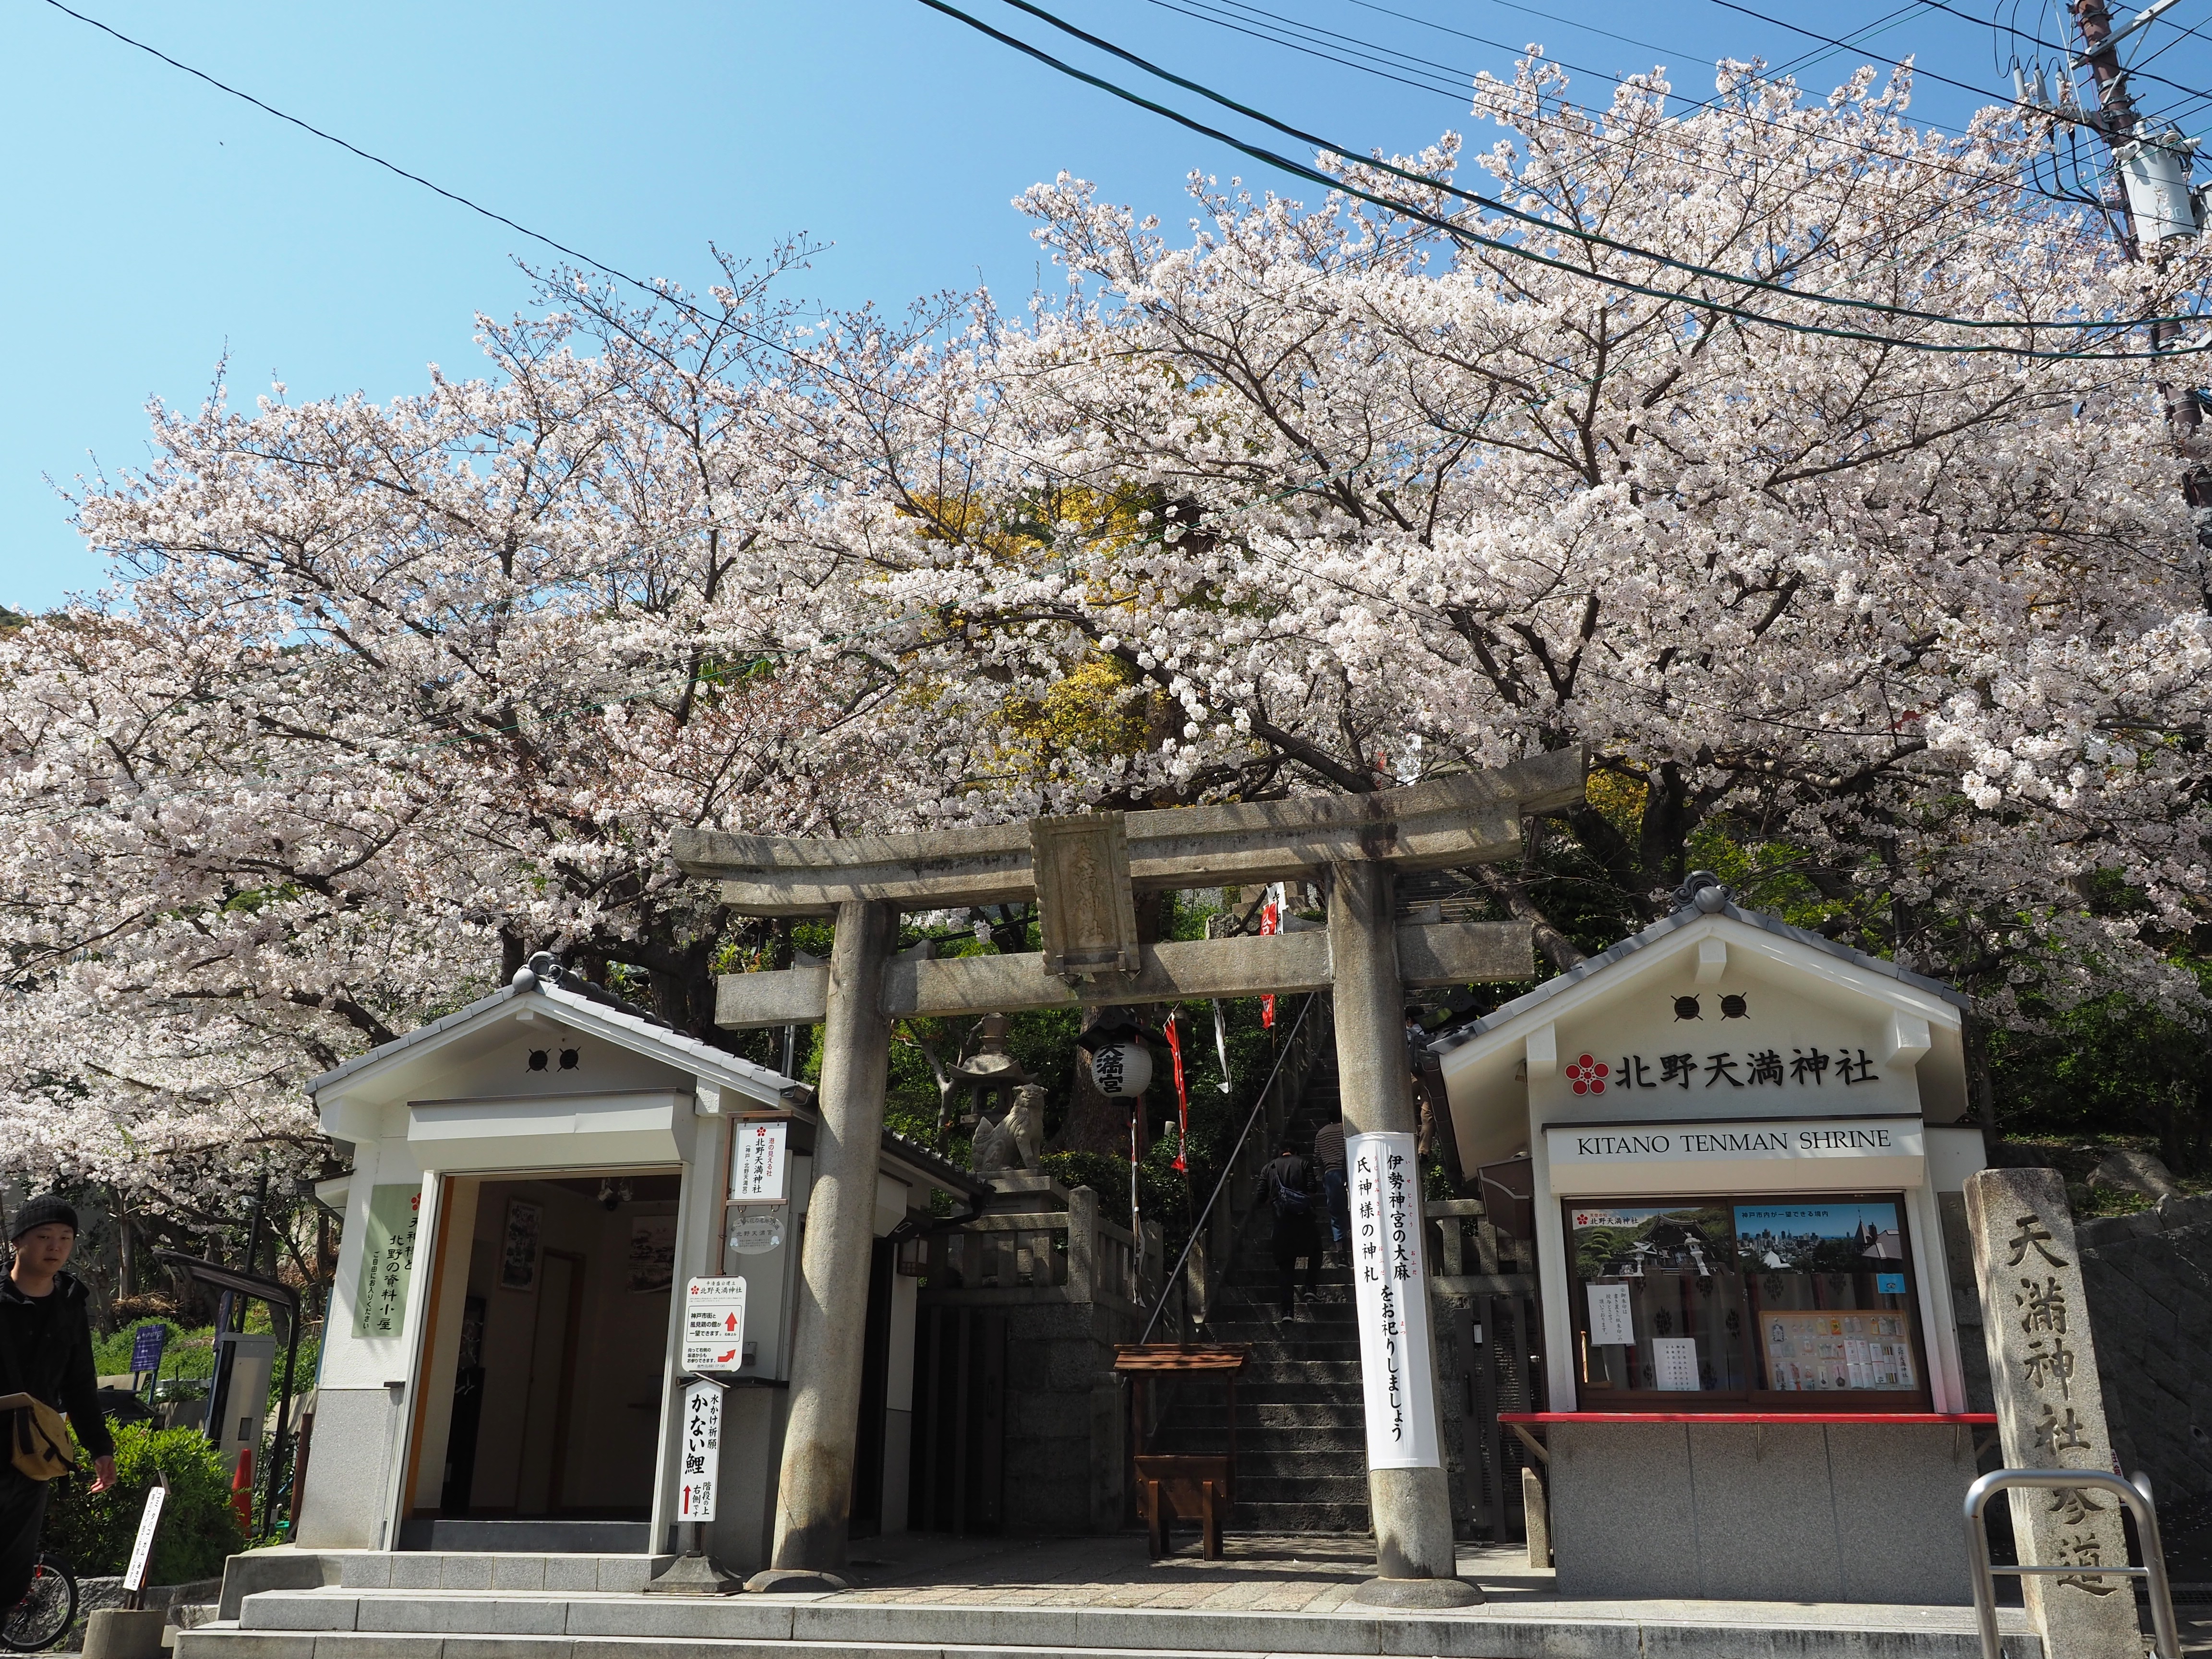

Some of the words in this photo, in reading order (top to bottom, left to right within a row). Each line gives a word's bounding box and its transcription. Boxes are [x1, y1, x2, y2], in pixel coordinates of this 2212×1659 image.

[1096, 1042, 1125, 1094] 天満宮
[1615, 1047, 1880, 1090] 北野天満神社
[752, 1138, 765, 1193] 北野天満神社
[1577, 1135, 1670, 1155] KITANO
[1680, 1132, 1788, 1153] TENMAN
[1800, 1130, 1891, 1150] SHRINE
[1358, 1156, 1379, 1283] 氏神様の神札
[1387, 1154, 1411, 1282] 伊勢神宮の大麻
[1590, 1217, 1639, 1225] 北野天満神社
[363, 1251, 380, 1329] ご自由にお入りください
[377, 1235, 405, 1331] 北野の資料小屋
[1381, 1285, 1404, 1443] をお祀りしましょう
[1897, 1346, 1909, 1378] 北野天満神社
[685, 1394, 708, 1475] かない鯉
[707, 1394, 719, 1450] 水かけ祈願
[692, 1484, 701, 1517] 右側です
[702, 1481, 711, 1515] 階段の上
